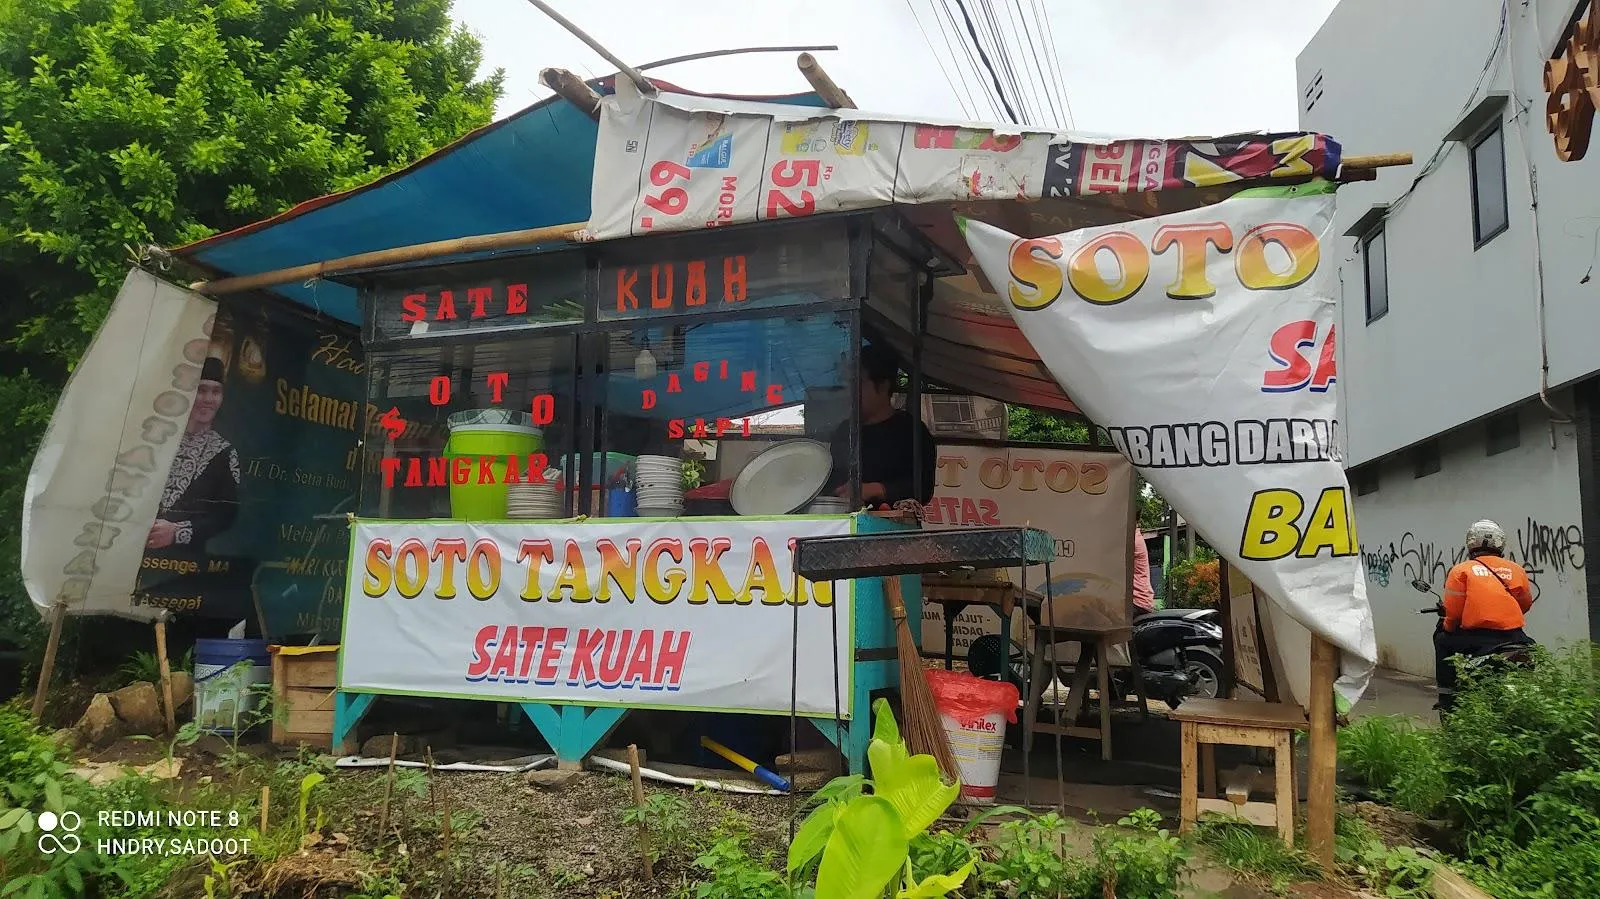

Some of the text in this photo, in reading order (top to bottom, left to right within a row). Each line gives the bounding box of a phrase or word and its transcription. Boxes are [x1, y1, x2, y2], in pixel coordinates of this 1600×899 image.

[767, 160, 820, 219] 52
[824, 166, 833, 180] Rp
[401, 255, 747, 323] SATE KUAH
[1007, 221, 1321, 311] SOTO
[380, 371, 555, 440] SOTO
[641, 359, 784, 409] DAGING
[667, 416, 751, 440] SAPI
[1235, 418, 1329, 464] DARI
[380, 453, 549, 488] TANGKAR
[1239, 487, 1357, 561] BA
[363, 537, 501, 601] SOTO
[465, 624, 693, 691] SATE KUAH
